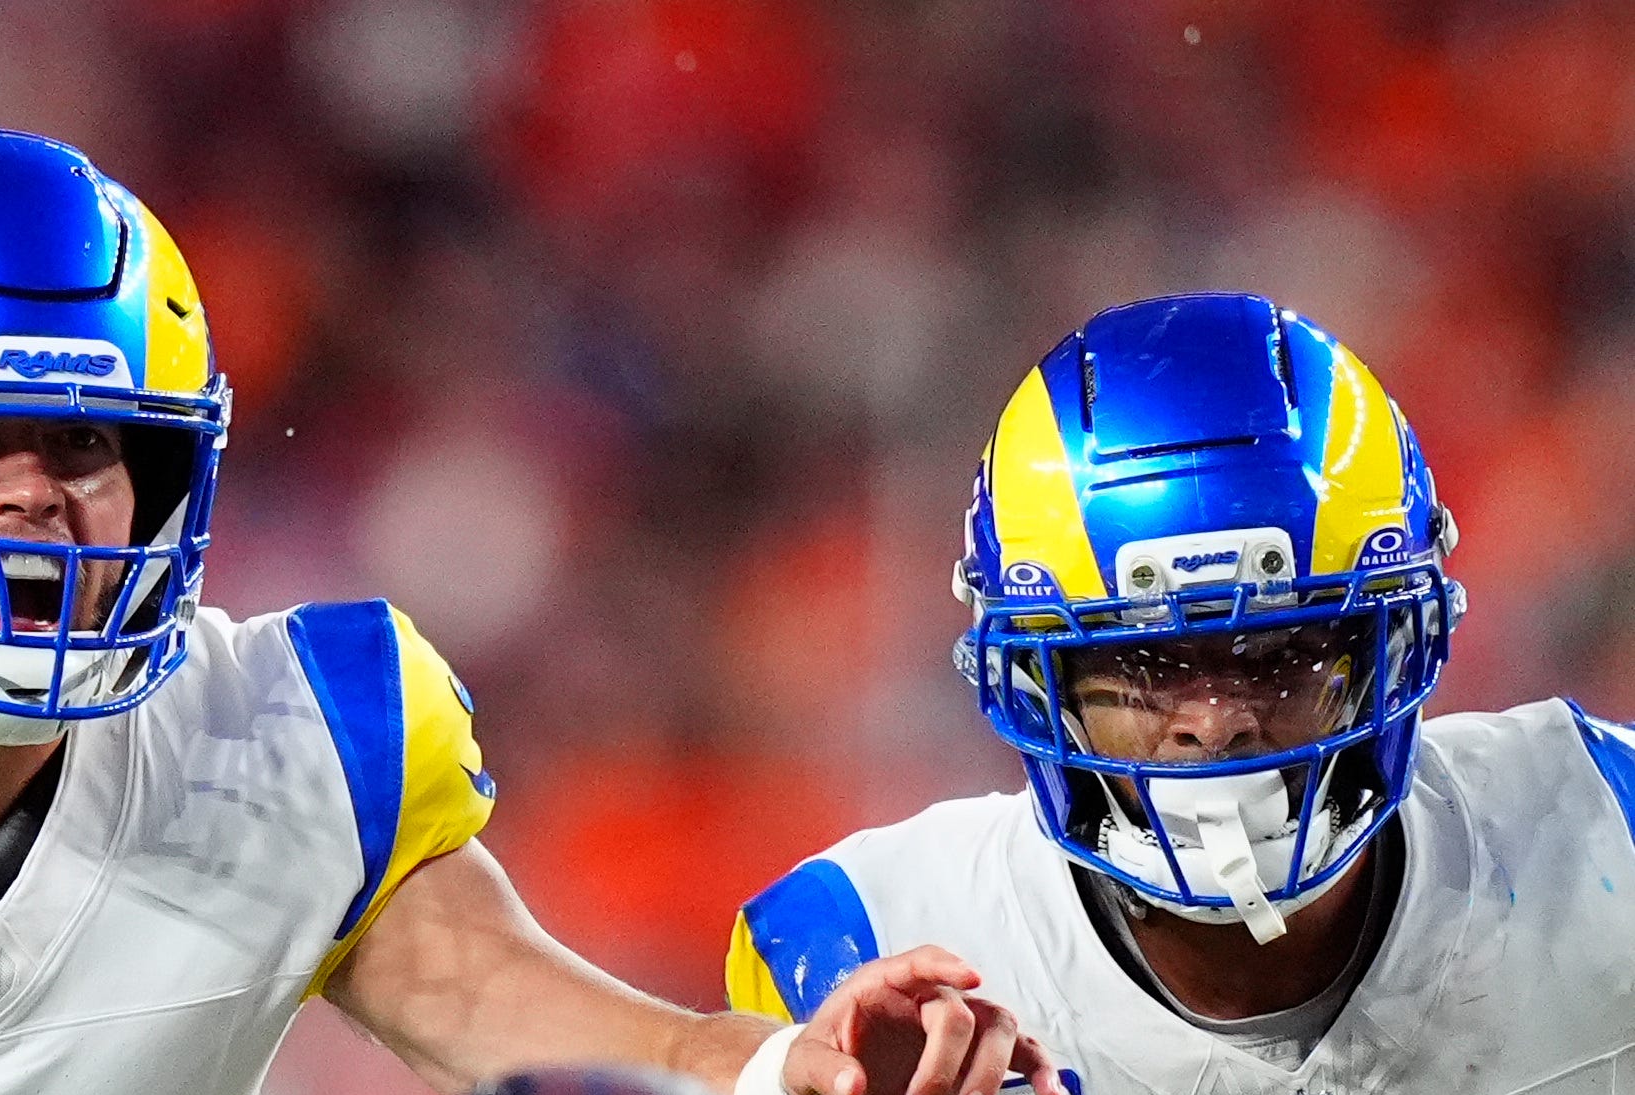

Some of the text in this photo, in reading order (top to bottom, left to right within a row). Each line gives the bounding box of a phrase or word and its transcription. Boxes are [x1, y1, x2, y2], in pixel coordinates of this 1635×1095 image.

[1171, 550, 1239, 573] RAMS
[1361, 550, 1410, 566] OAKLEY
[1003, 585, 1055, 597] OAKLEY
